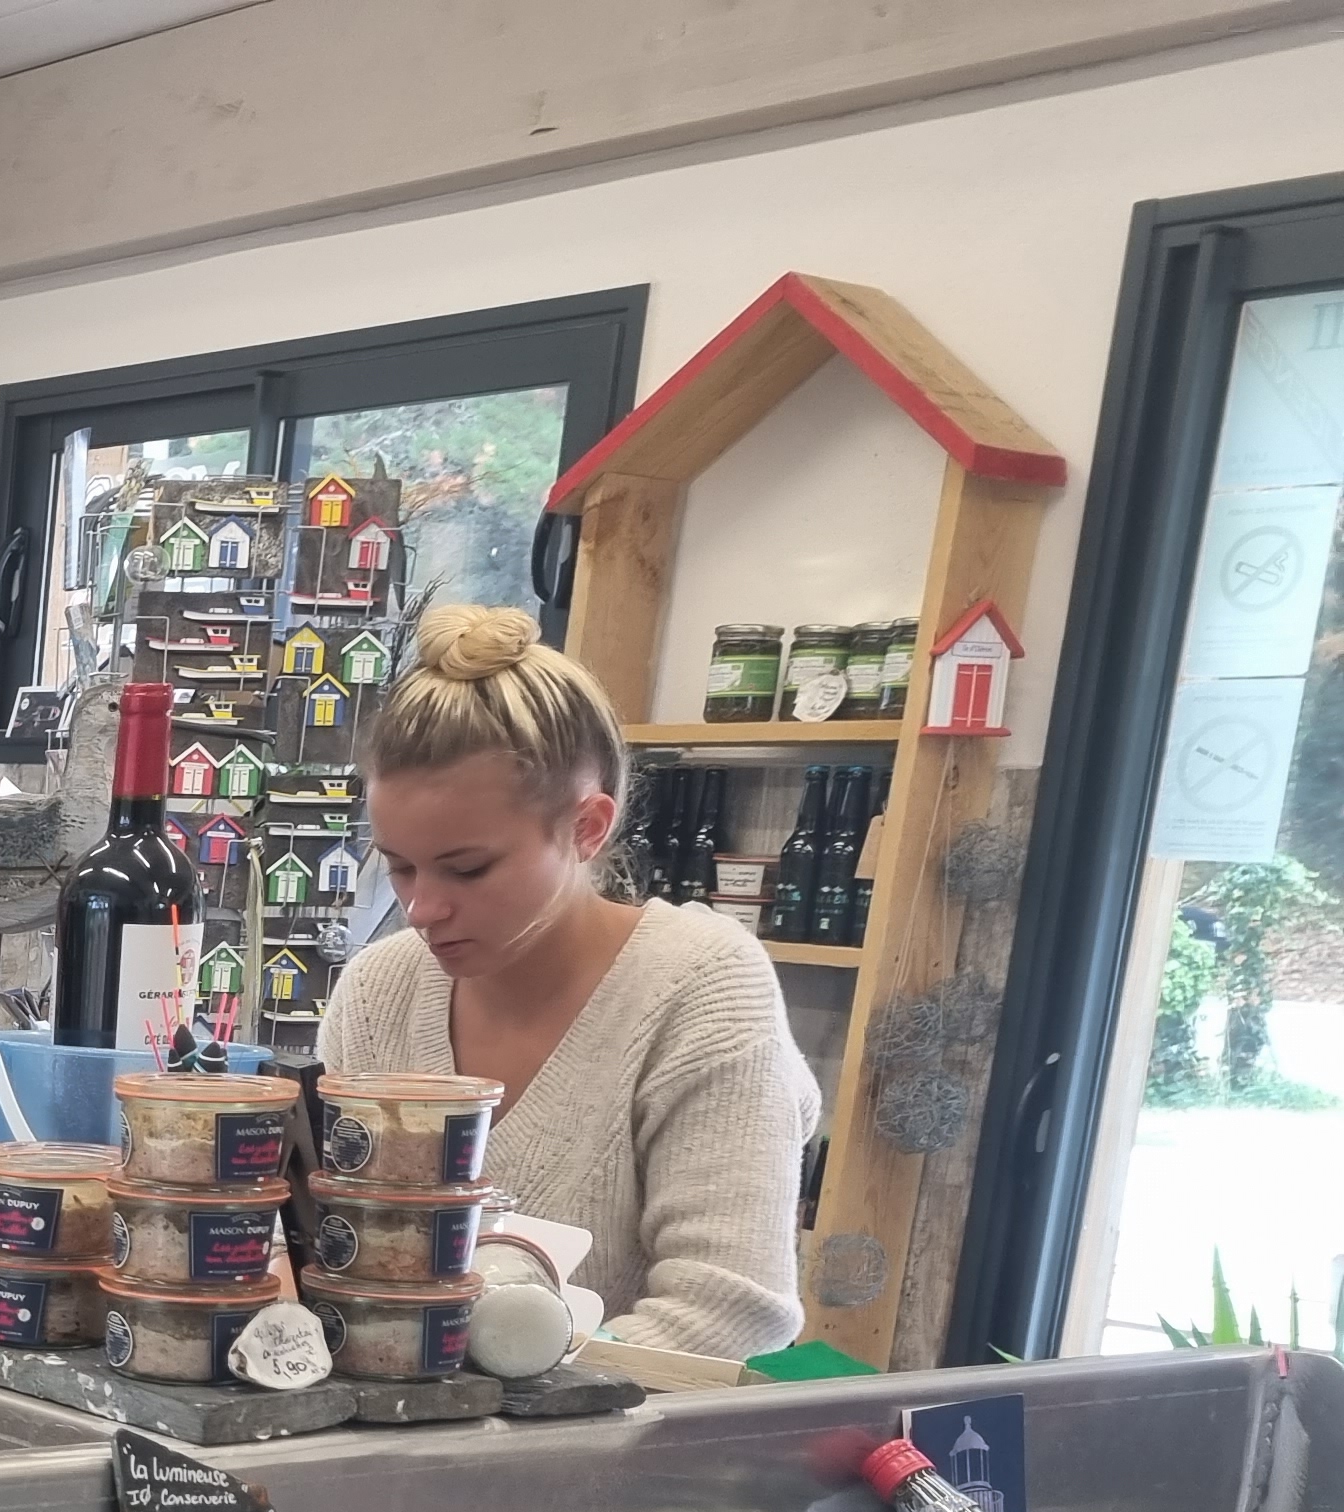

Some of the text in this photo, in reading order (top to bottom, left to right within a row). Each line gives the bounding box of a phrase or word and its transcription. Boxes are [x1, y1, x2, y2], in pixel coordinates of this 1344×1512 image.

[138, 989, 177, 999] GÉRAR
[6, 1198, 40, 1210] DUPUY
[208, 1225, 245, 1236] MAISON
